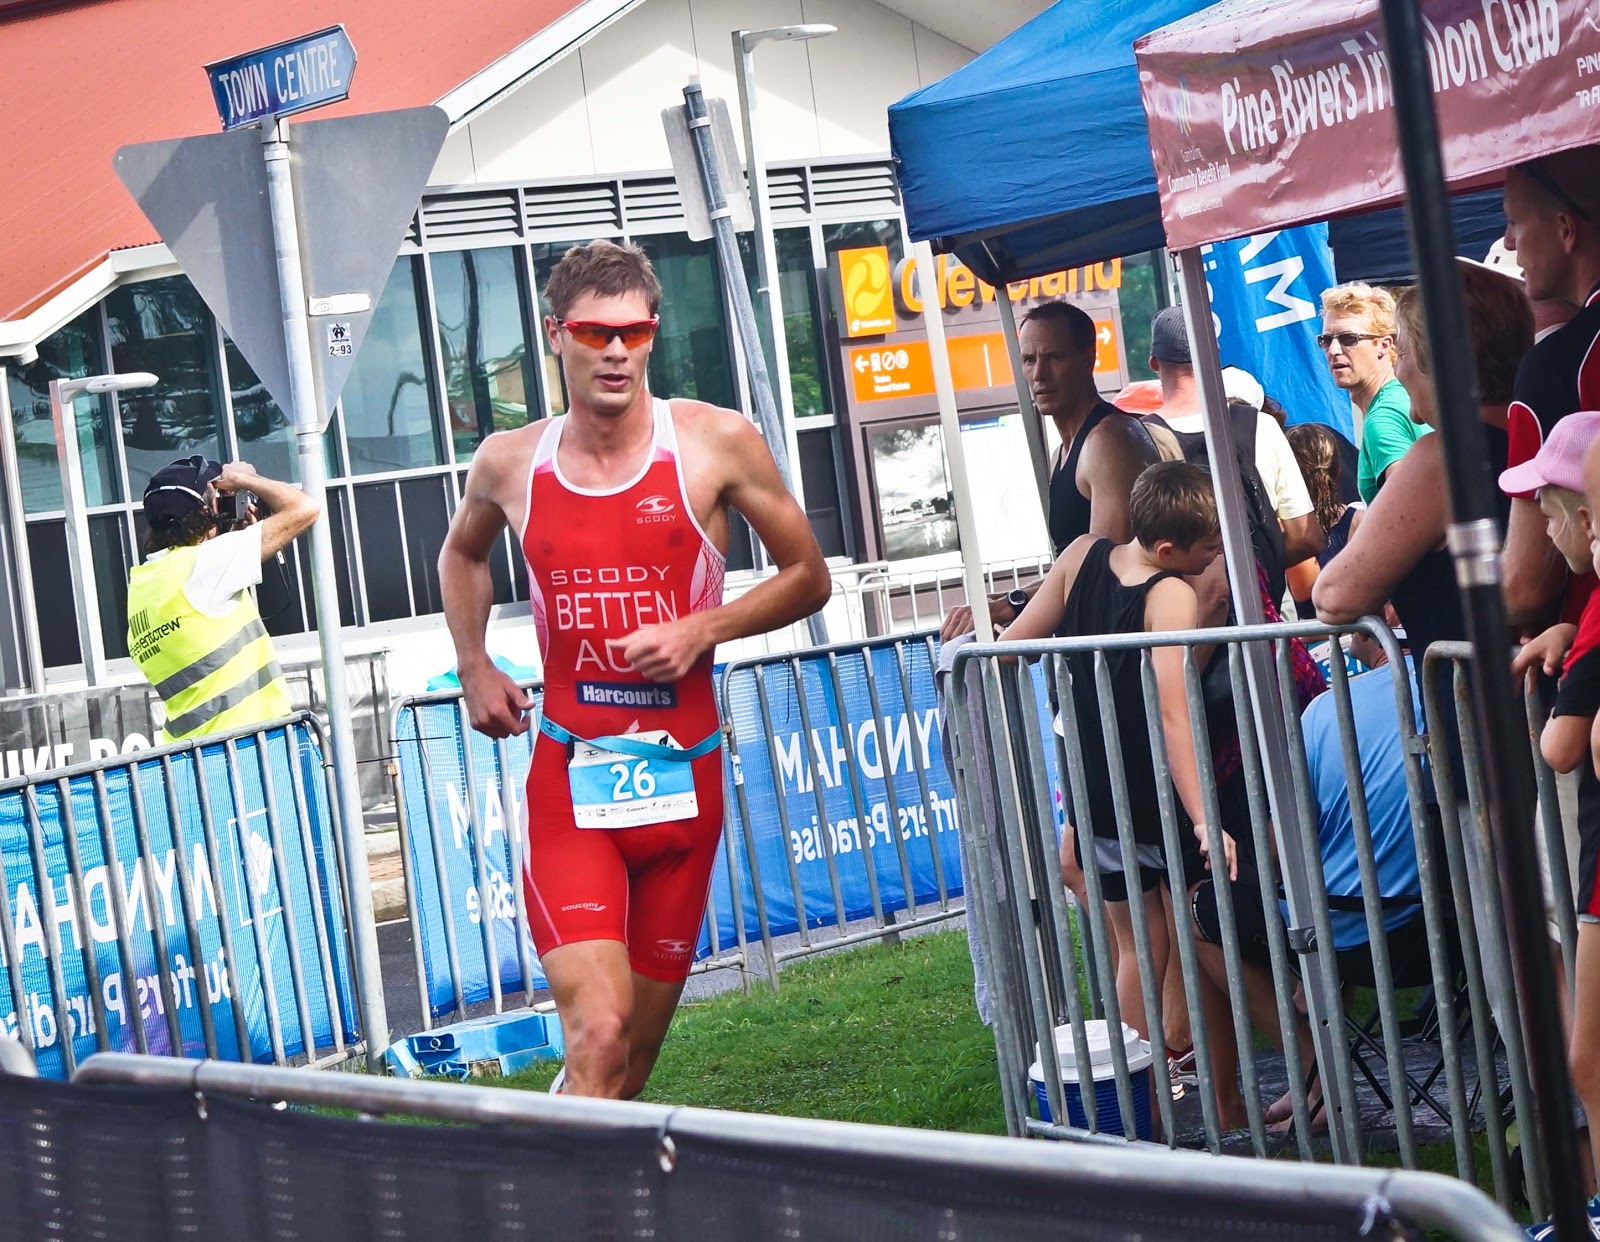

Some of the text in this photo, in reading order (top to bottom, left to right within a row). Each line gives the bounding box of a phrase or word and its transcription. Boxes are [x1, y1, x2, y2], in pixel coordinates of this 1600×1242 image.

[218, 40, 341, 118] TOWN CENTRE
[1221, 0, 1561, 155] Pine Rivers Trilon Club
[636, 514, 677, 525] SCODY
[551, 565, 671, 586] SCODY
[555, 590, 678, 631] BETTEN
[582, 684, 672, 706] Harcourts
[609, 760, 656, 802] 26
